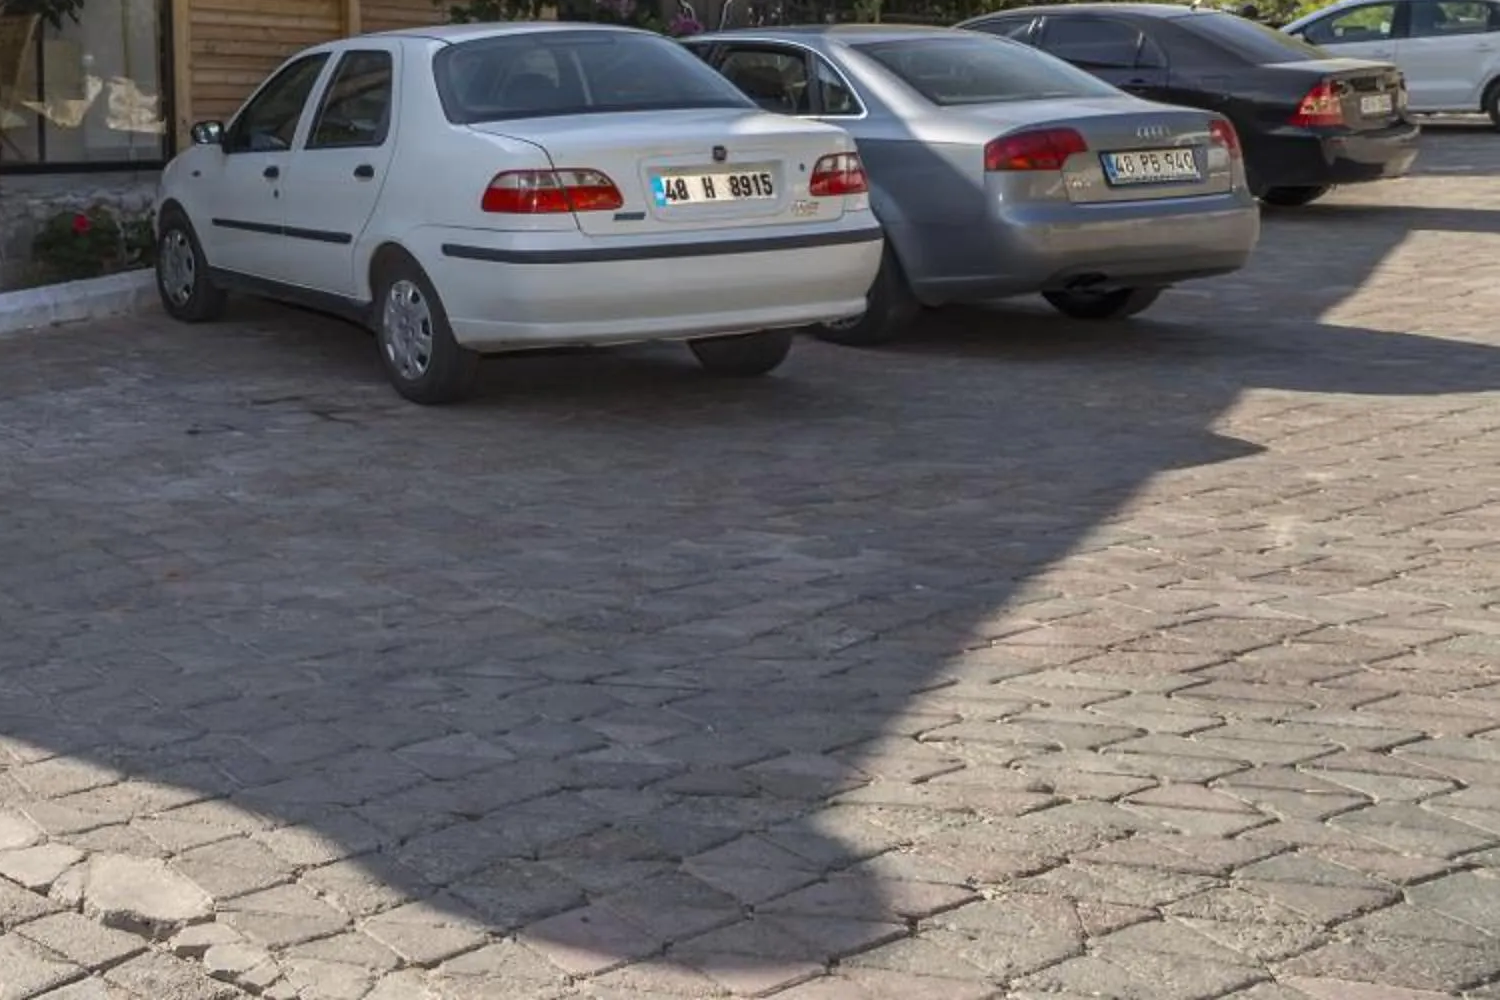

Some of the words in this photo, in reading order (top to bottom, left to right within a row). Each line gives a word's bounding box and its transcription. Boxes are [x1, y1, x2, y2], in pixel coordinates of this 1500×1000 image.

[664, 178, 690, 201] 48
[701, 176, 716, 199] H
[729, 173, 773, 198] 8915
